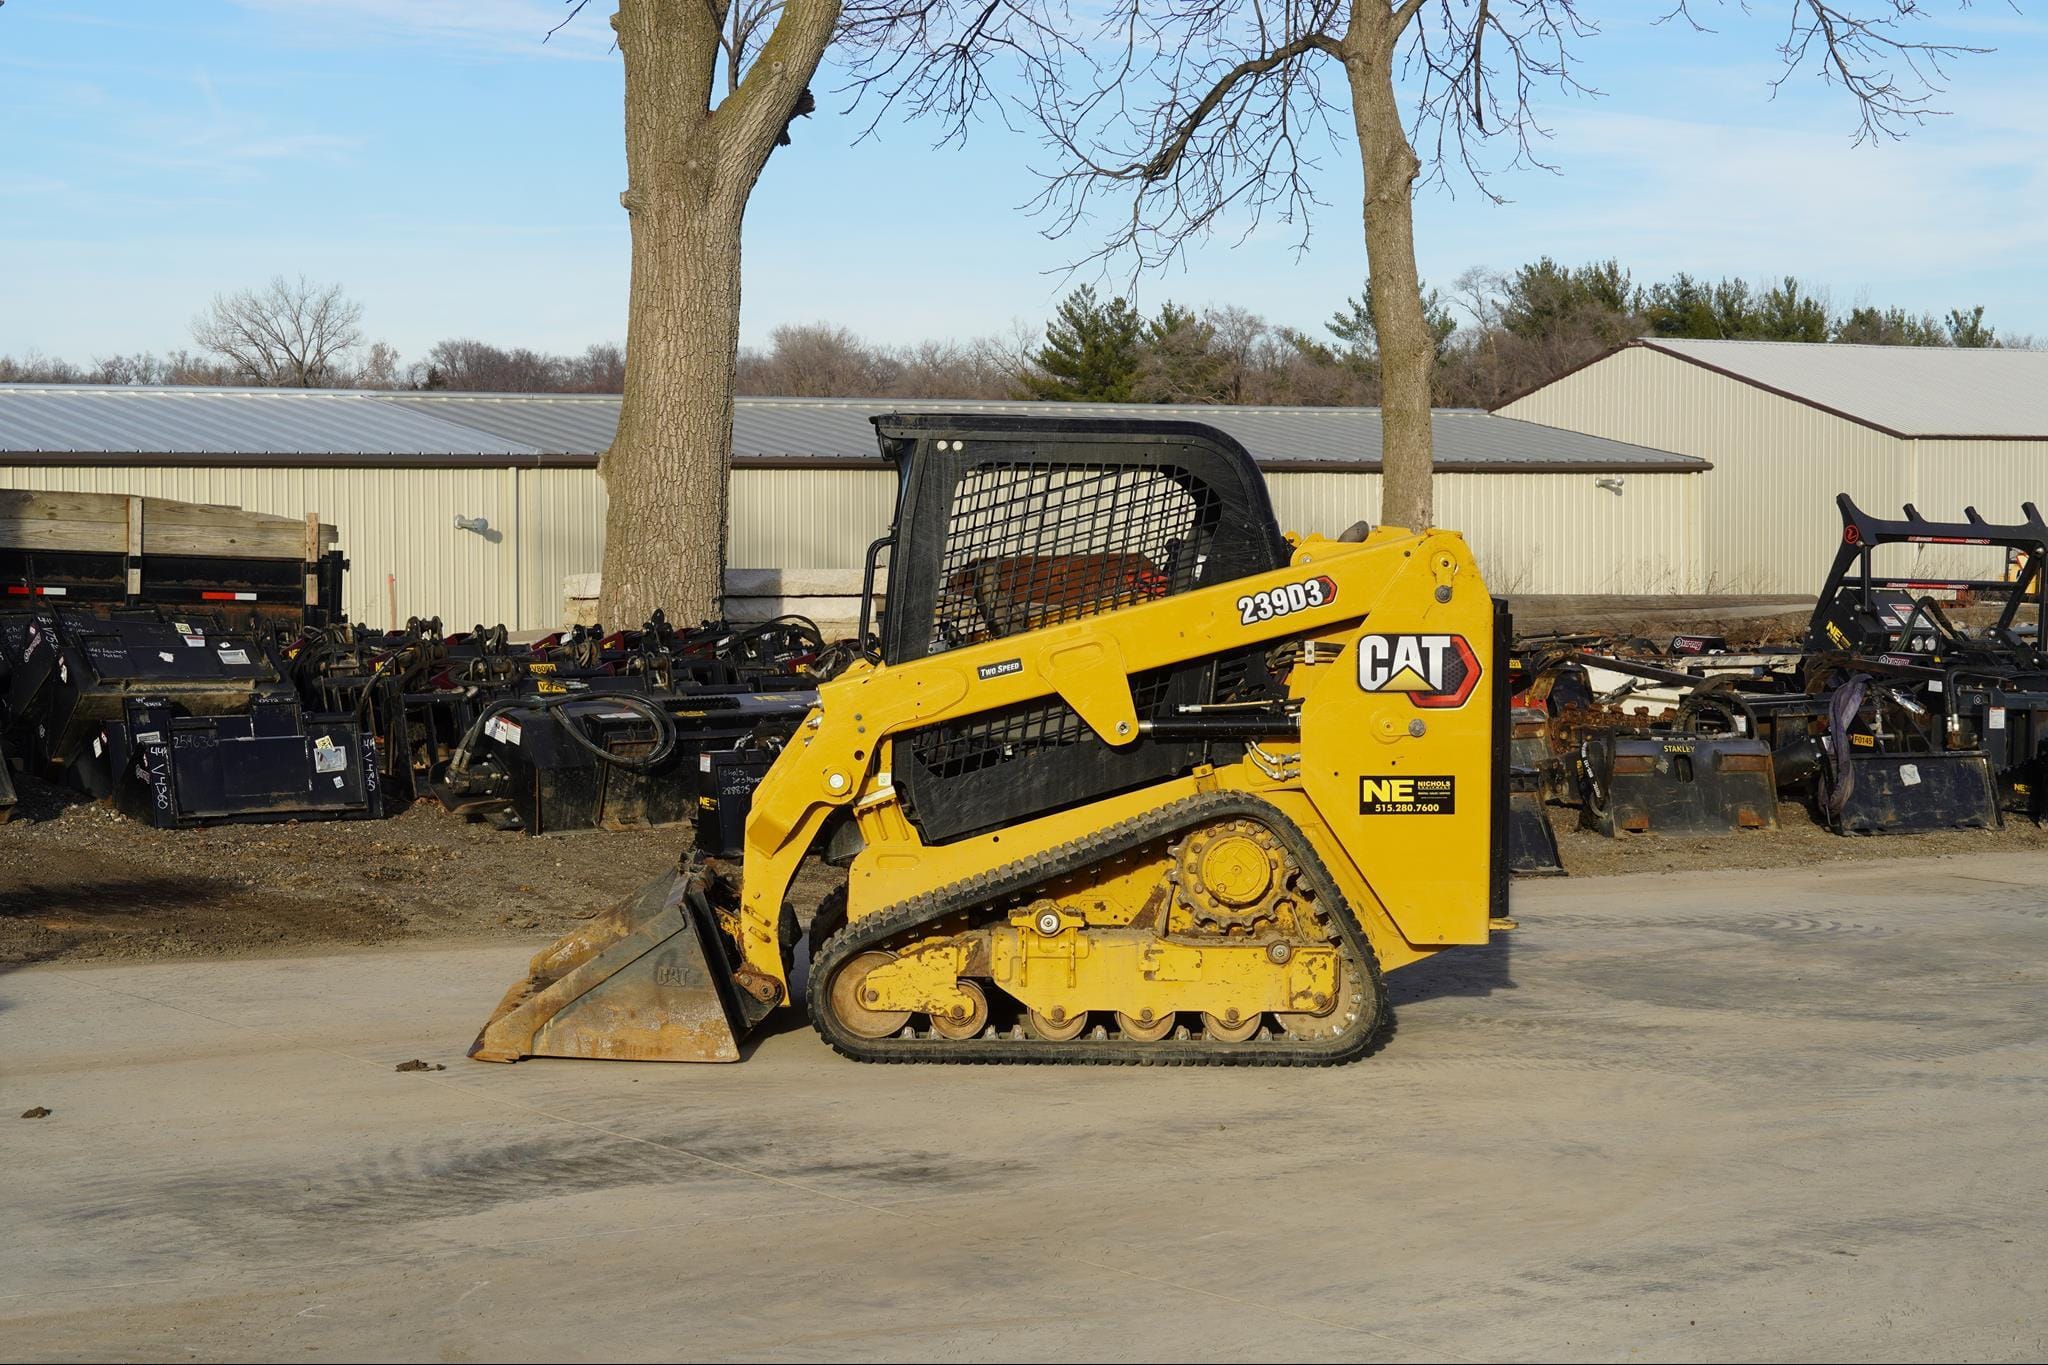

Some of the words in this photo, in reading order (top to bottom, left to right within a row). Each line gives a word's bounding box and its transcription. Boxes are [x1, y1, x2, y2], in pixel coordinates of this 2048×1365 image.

[1238, 578, 1323, 624] 239D3
[980, 667, 997, 677] Two
[998, 662, 1019, 673] Speed
[1359, 634, 1451, 691] CAT
[1854, 735, 1873, 745] F0145
[1663, 744, 1696, 753] STANLEY
[1363, 780, 1415, 803] NE
[1375, 803, 1440, 813] 515.280.7600
